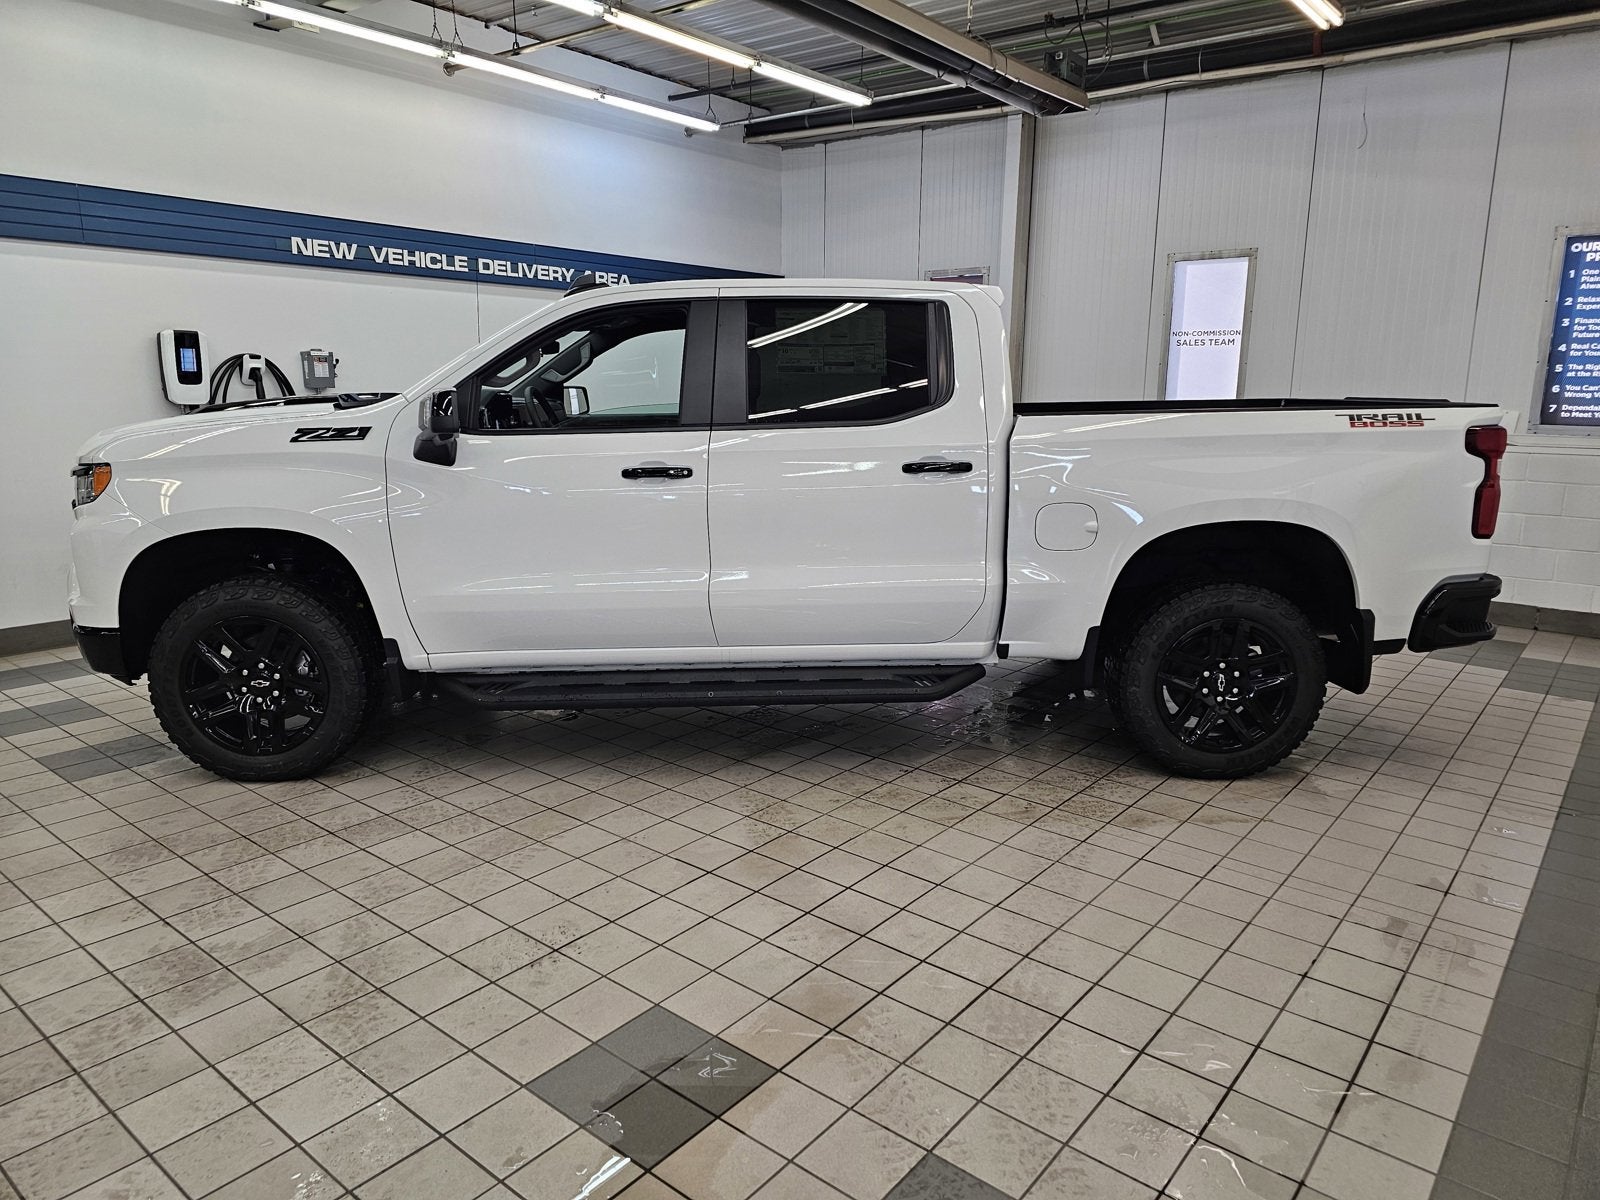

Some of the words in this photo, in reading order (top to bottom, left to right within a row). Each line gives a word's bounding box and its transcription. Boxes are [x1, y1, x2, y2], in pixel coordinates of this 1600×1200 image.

[290, 236, 358, 260] NEW
[368, 245, 469, 272] VEHICLE
[478, 257, 575, 283] DELIVERY
[583, 269, 630, 287] REA
[1569, 269, 1576, 278] 1
[1564, 297, 1573, 306] 2
[1561, 318, 1570, 327] 3
[1172, 329, 1241, 337] NON-COMMISSION
[1176, 339, 1206, 347] SALES
[1208, 338, 1236, 346] TEAM
[1558, 343, 1567, 352] 4
[1554, 364, 1564, 373] 5
[1551, 385, 1561, 393] 6
[1549, 404, 1557, 413] 7
[1335, 413, 1436, 421] TRAIL
